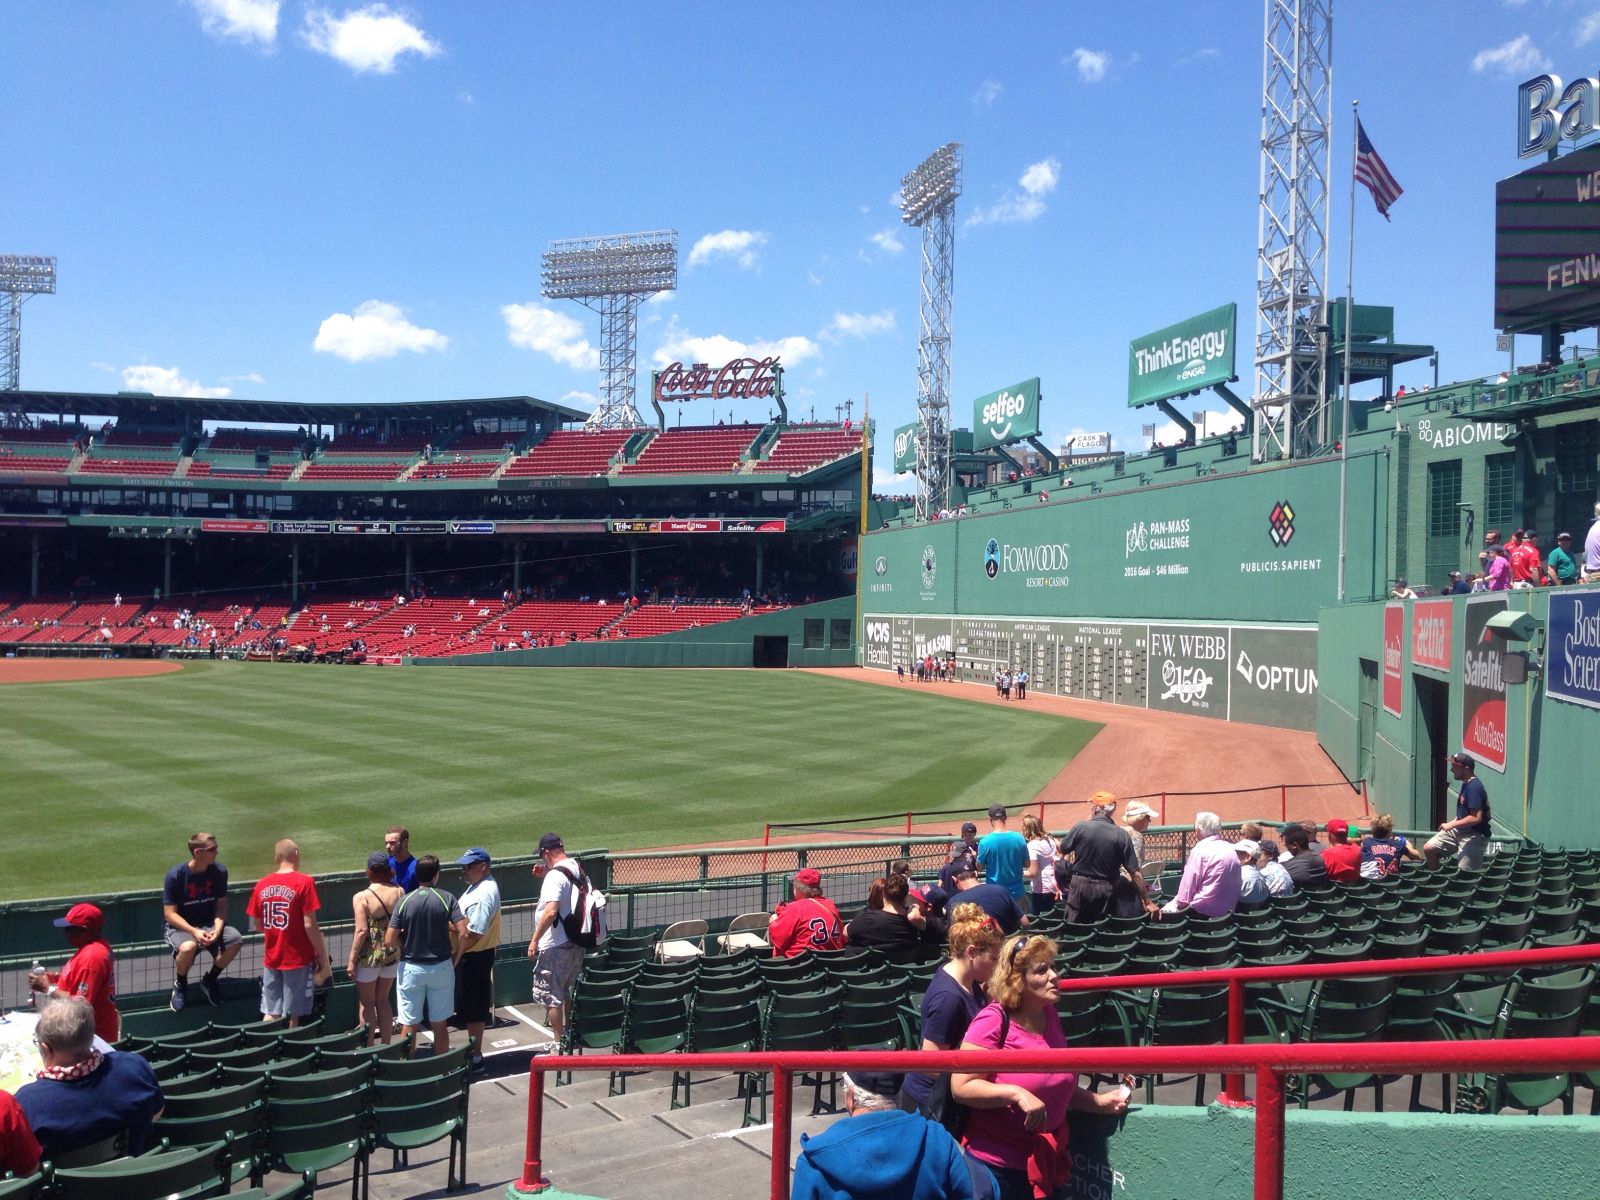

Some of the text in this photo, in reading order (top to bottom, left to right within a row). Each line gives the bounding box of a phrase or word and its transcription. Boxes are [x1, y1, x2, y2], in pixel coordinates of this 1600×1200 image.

[1135, 329, 1227, 376] ThinkEnergy
[655, 356, 780, 402] Coca-Cola
[982, 391, 1025, 425] selfeo
[1077, 440, 1106, 448] FLAGO
[614, 522, 632, 532] Tribe
[1150, 519, 1190, 535] PAN-MASS
[1150, 536, 1190, 550] CHALLENGE
[841, 551, 858, 569] Gul
[1240, 559, 1321, 572] PUBLICIS.SAPIENT
[1124, 567, 1137, 577] 2016
[1137, 566, 1151, 577] Goal
[1156, 565, 1167, 576] $46
[1167, 564, 1189, 575] Million
[1049, 576, 1069, 587] CASINO
[874, 621, 890, 643] CVS
[1014, 623, 1034, 631] AMERICAN
[1079, 626, 1122, 636] NATIONAL LEAGUE
[1151, 634, 1226, 660] F.W. WEBB
[1417, 616, 1446, 660] aetna
[867, 643, 890, 665] Health
[1473, 715, 1504, 753] AutoGlass
[259, 885, 296, 901] PEDROIA
[263, 901, 290, 930] 15
[809, 916, 842, 946] 34
